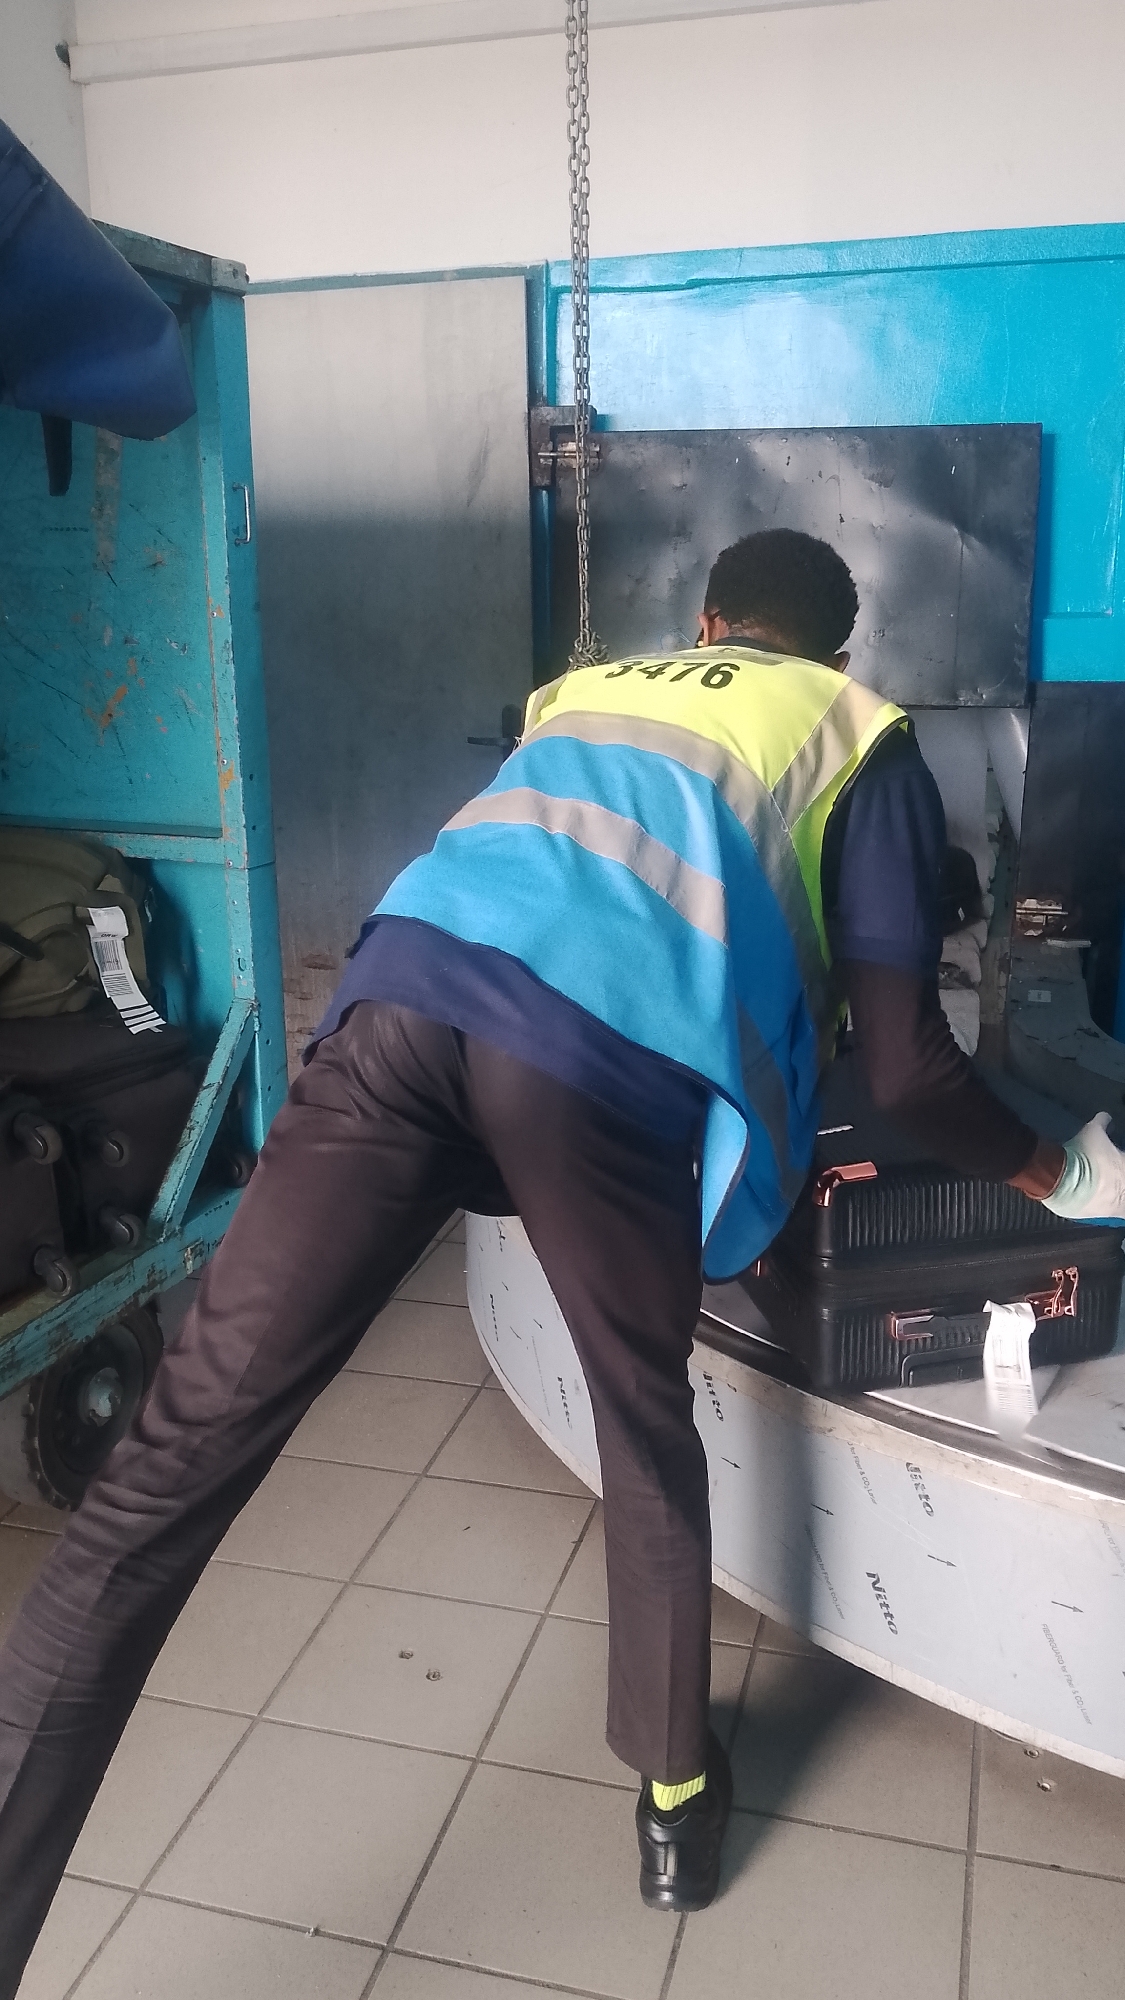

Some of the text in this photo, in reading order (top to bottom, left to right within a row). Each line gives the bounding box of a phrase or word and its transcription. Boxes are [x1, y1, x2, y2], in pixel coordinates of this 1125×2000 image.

[604, 661, 741, 690] 3476
[866, 1571, 899, 1635] Nitto
[1041, 1623, 1066, 1666] FIBERGUARD
